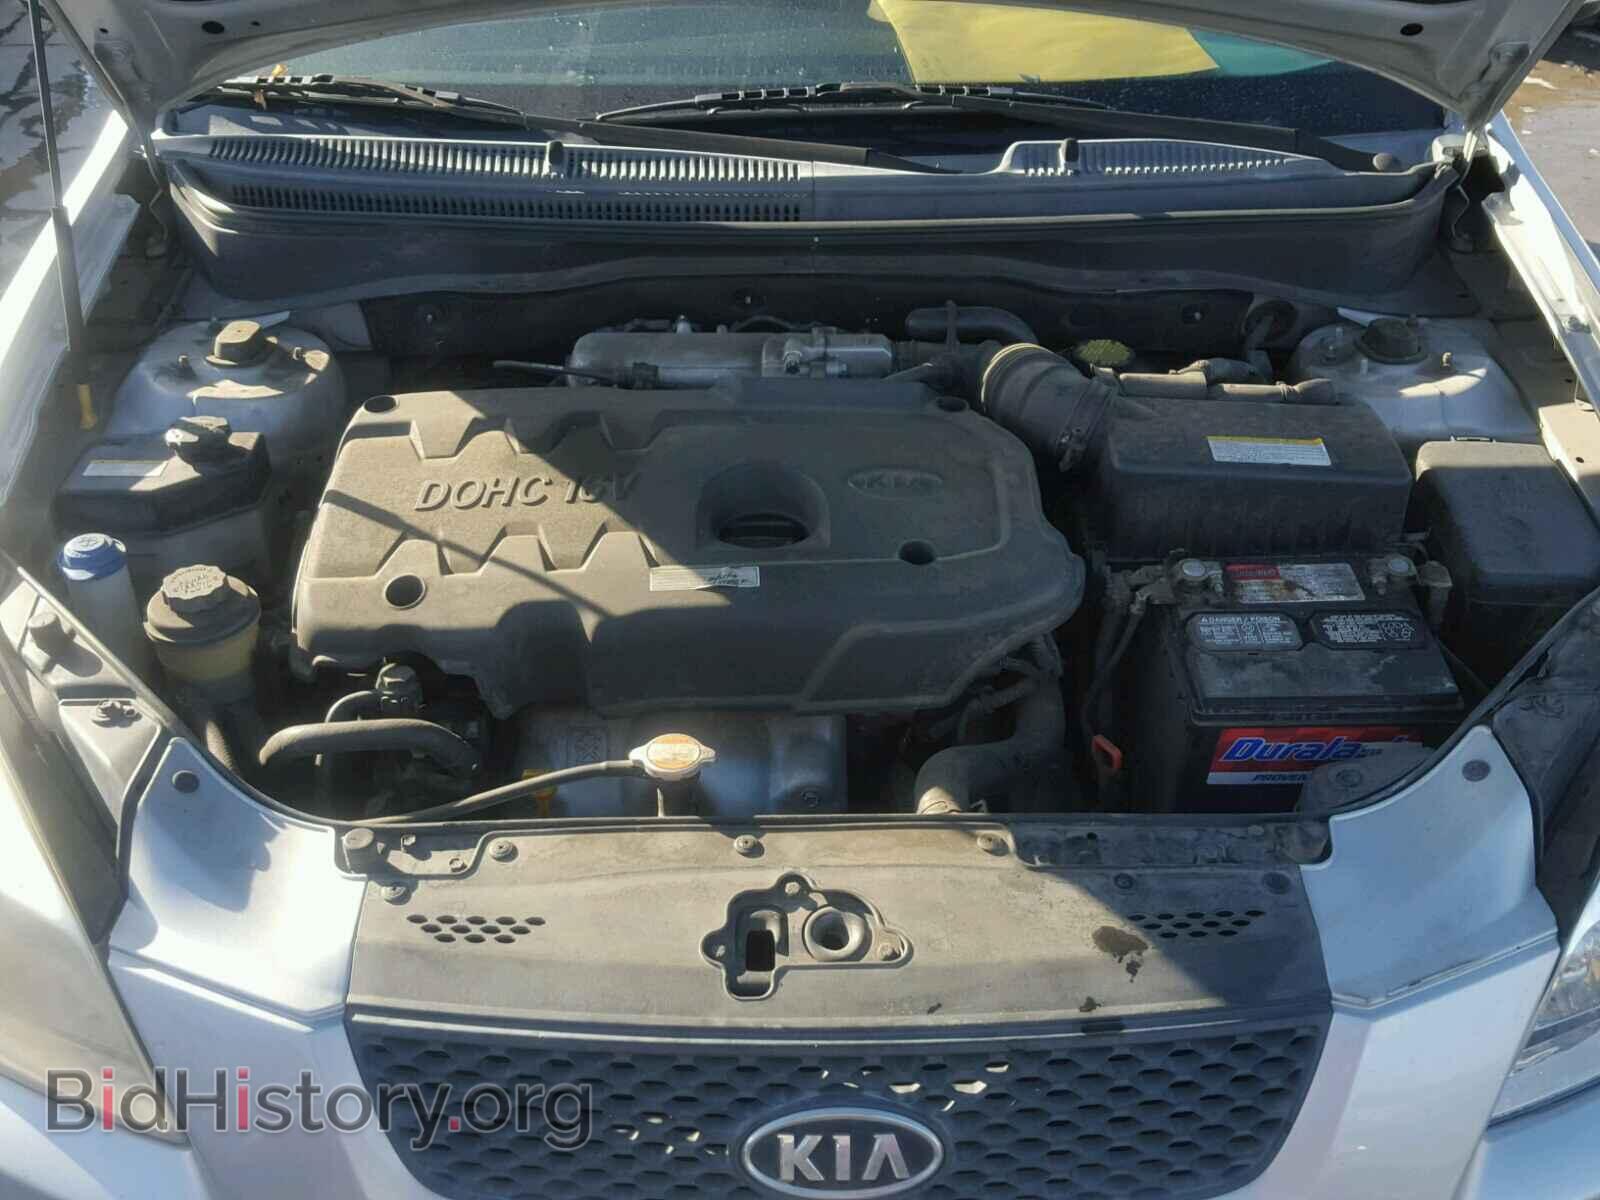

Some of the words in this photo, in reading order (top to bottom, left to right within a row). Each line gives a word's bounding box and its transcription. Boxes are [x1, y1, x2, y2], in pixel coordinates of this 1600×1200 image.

[414, 477, 553, 512] DOHC
[1219, 736, 1409, 762] Durala
[776, 1133, 911, 1181] KIA
